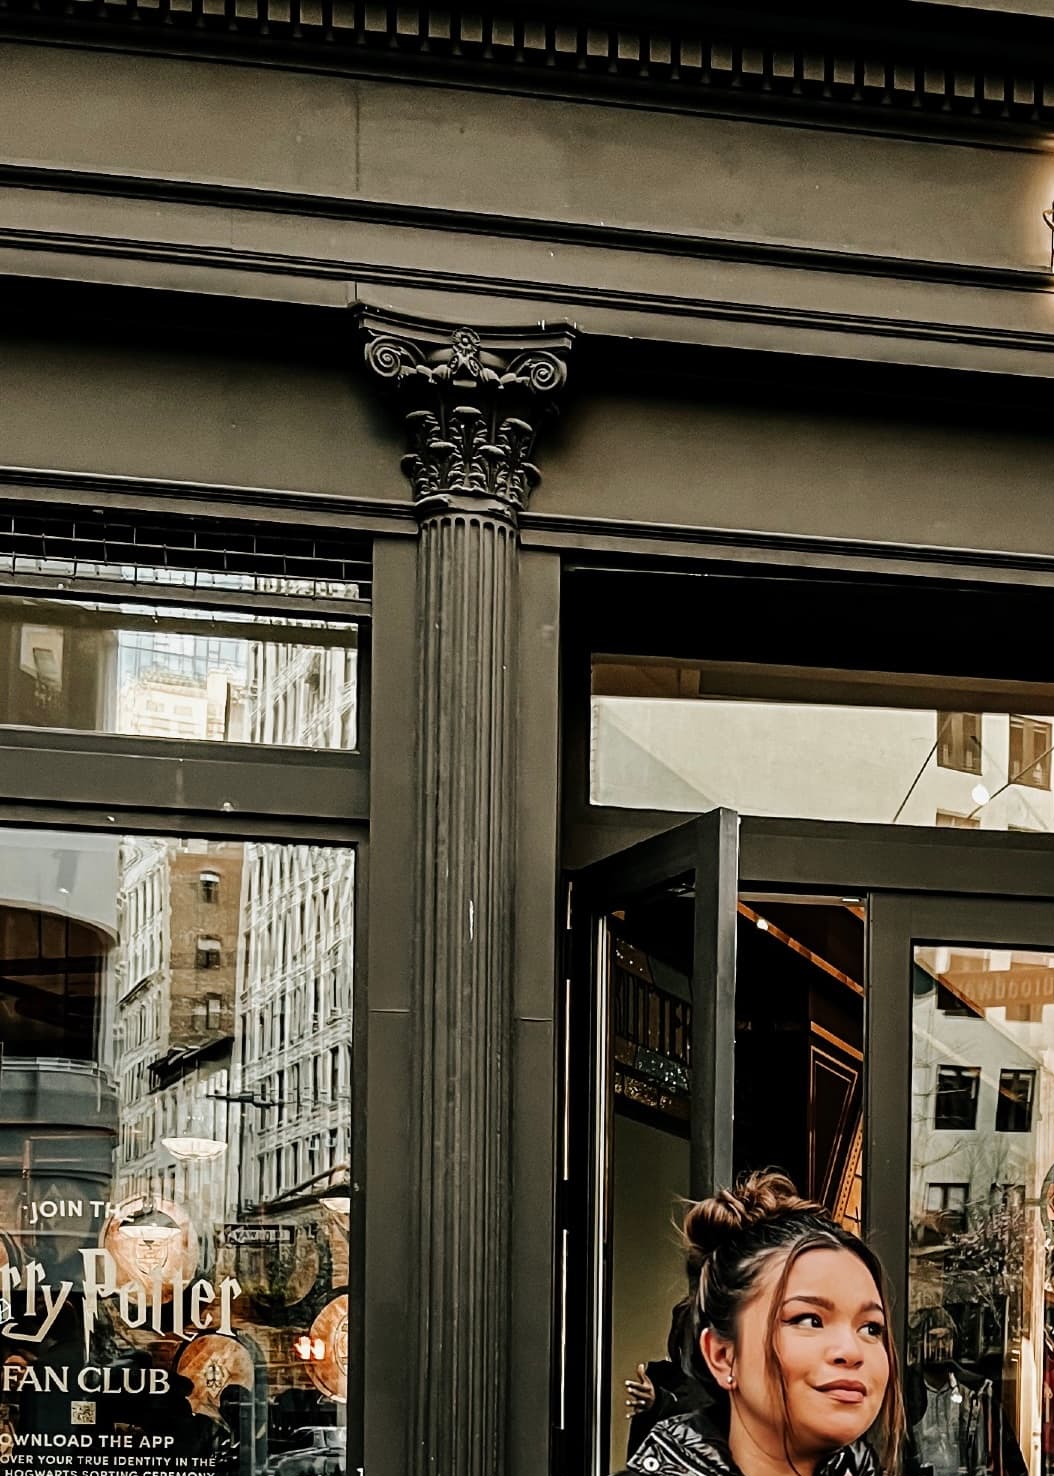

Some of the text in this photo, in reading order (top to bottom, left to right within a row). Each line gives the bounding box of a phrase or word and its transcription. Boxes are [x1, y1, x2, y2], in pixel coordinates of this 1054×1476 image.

[30, 1200, 83, 1224] JOIN
[78, 1248, 243, 1364] Potter
[2, 1365, 171, 1395] FAN CLUB
[98, 1434, 134, 1448] THE
[139, 1435, 175, 1449] APP
[37, 1455, 74, 1465] YOUR
[77, 1455, 109, 1466] TRUE
[113, 1456, 171, 1467] IDENTITY
[175, 1457, 188, 1467] IN
[192, 1457, 216, 1468] THE
